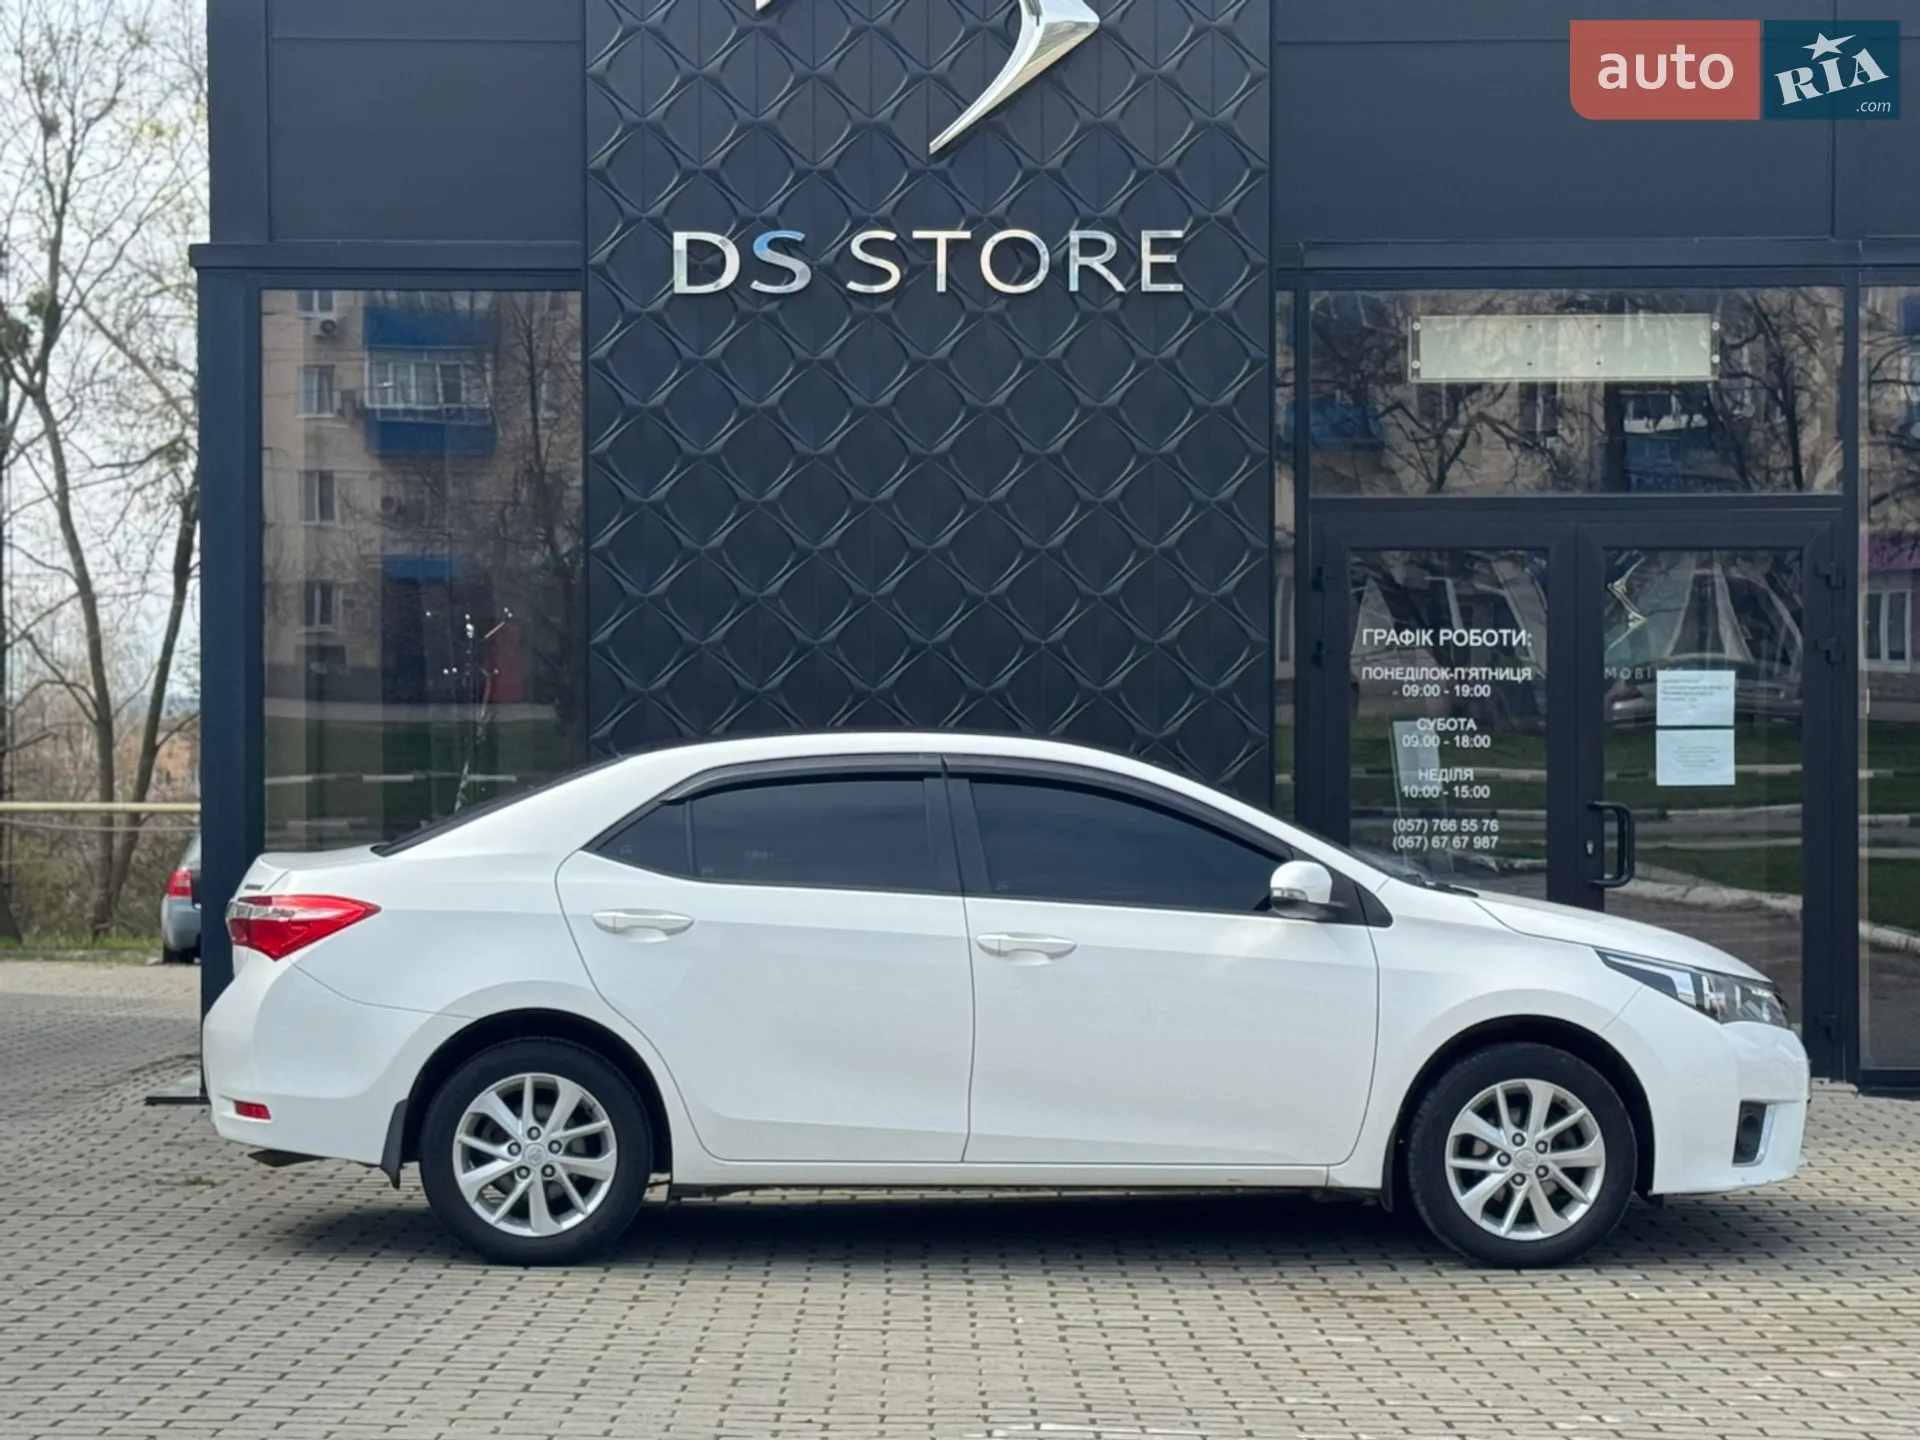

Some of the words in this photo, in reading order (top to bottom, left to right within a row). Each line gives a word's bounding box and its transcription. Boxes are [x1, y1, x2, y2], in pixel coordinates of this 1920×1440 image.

[673, 230, 812, 295] DS
[846, 229, 1185, 295] STORE
[1362, 628, 1434, 647] ГРАФІК
[1439, 628, 1532, 647] РОБОТИ:
[1402, 684, 1441, 697] 09:00
[1453, 684, 1491, 697] 19:00
[1416, 717, 1477, 732] СУБОТА
[1453, 734, 1492, 748] 18:00
[1418, 768, 1474, 783] НЕДІЛЯ
[1403, 785, 1440, 798] 10:00
[1453, 785, 1491, 798] 15:00
[1392, 818, 1428, 834] (057)
[1431, 818, 1457, 832] 766
[1461, 818, 1478, 832] 55
[1482, 818, 1499, 832] 76
[1392, 835, 1428, 851] (067)
[1431, 835, 1448, 849] 67
[1452, 835, 1469, 849] 67
[1473, 835, 1499, 849] 987
